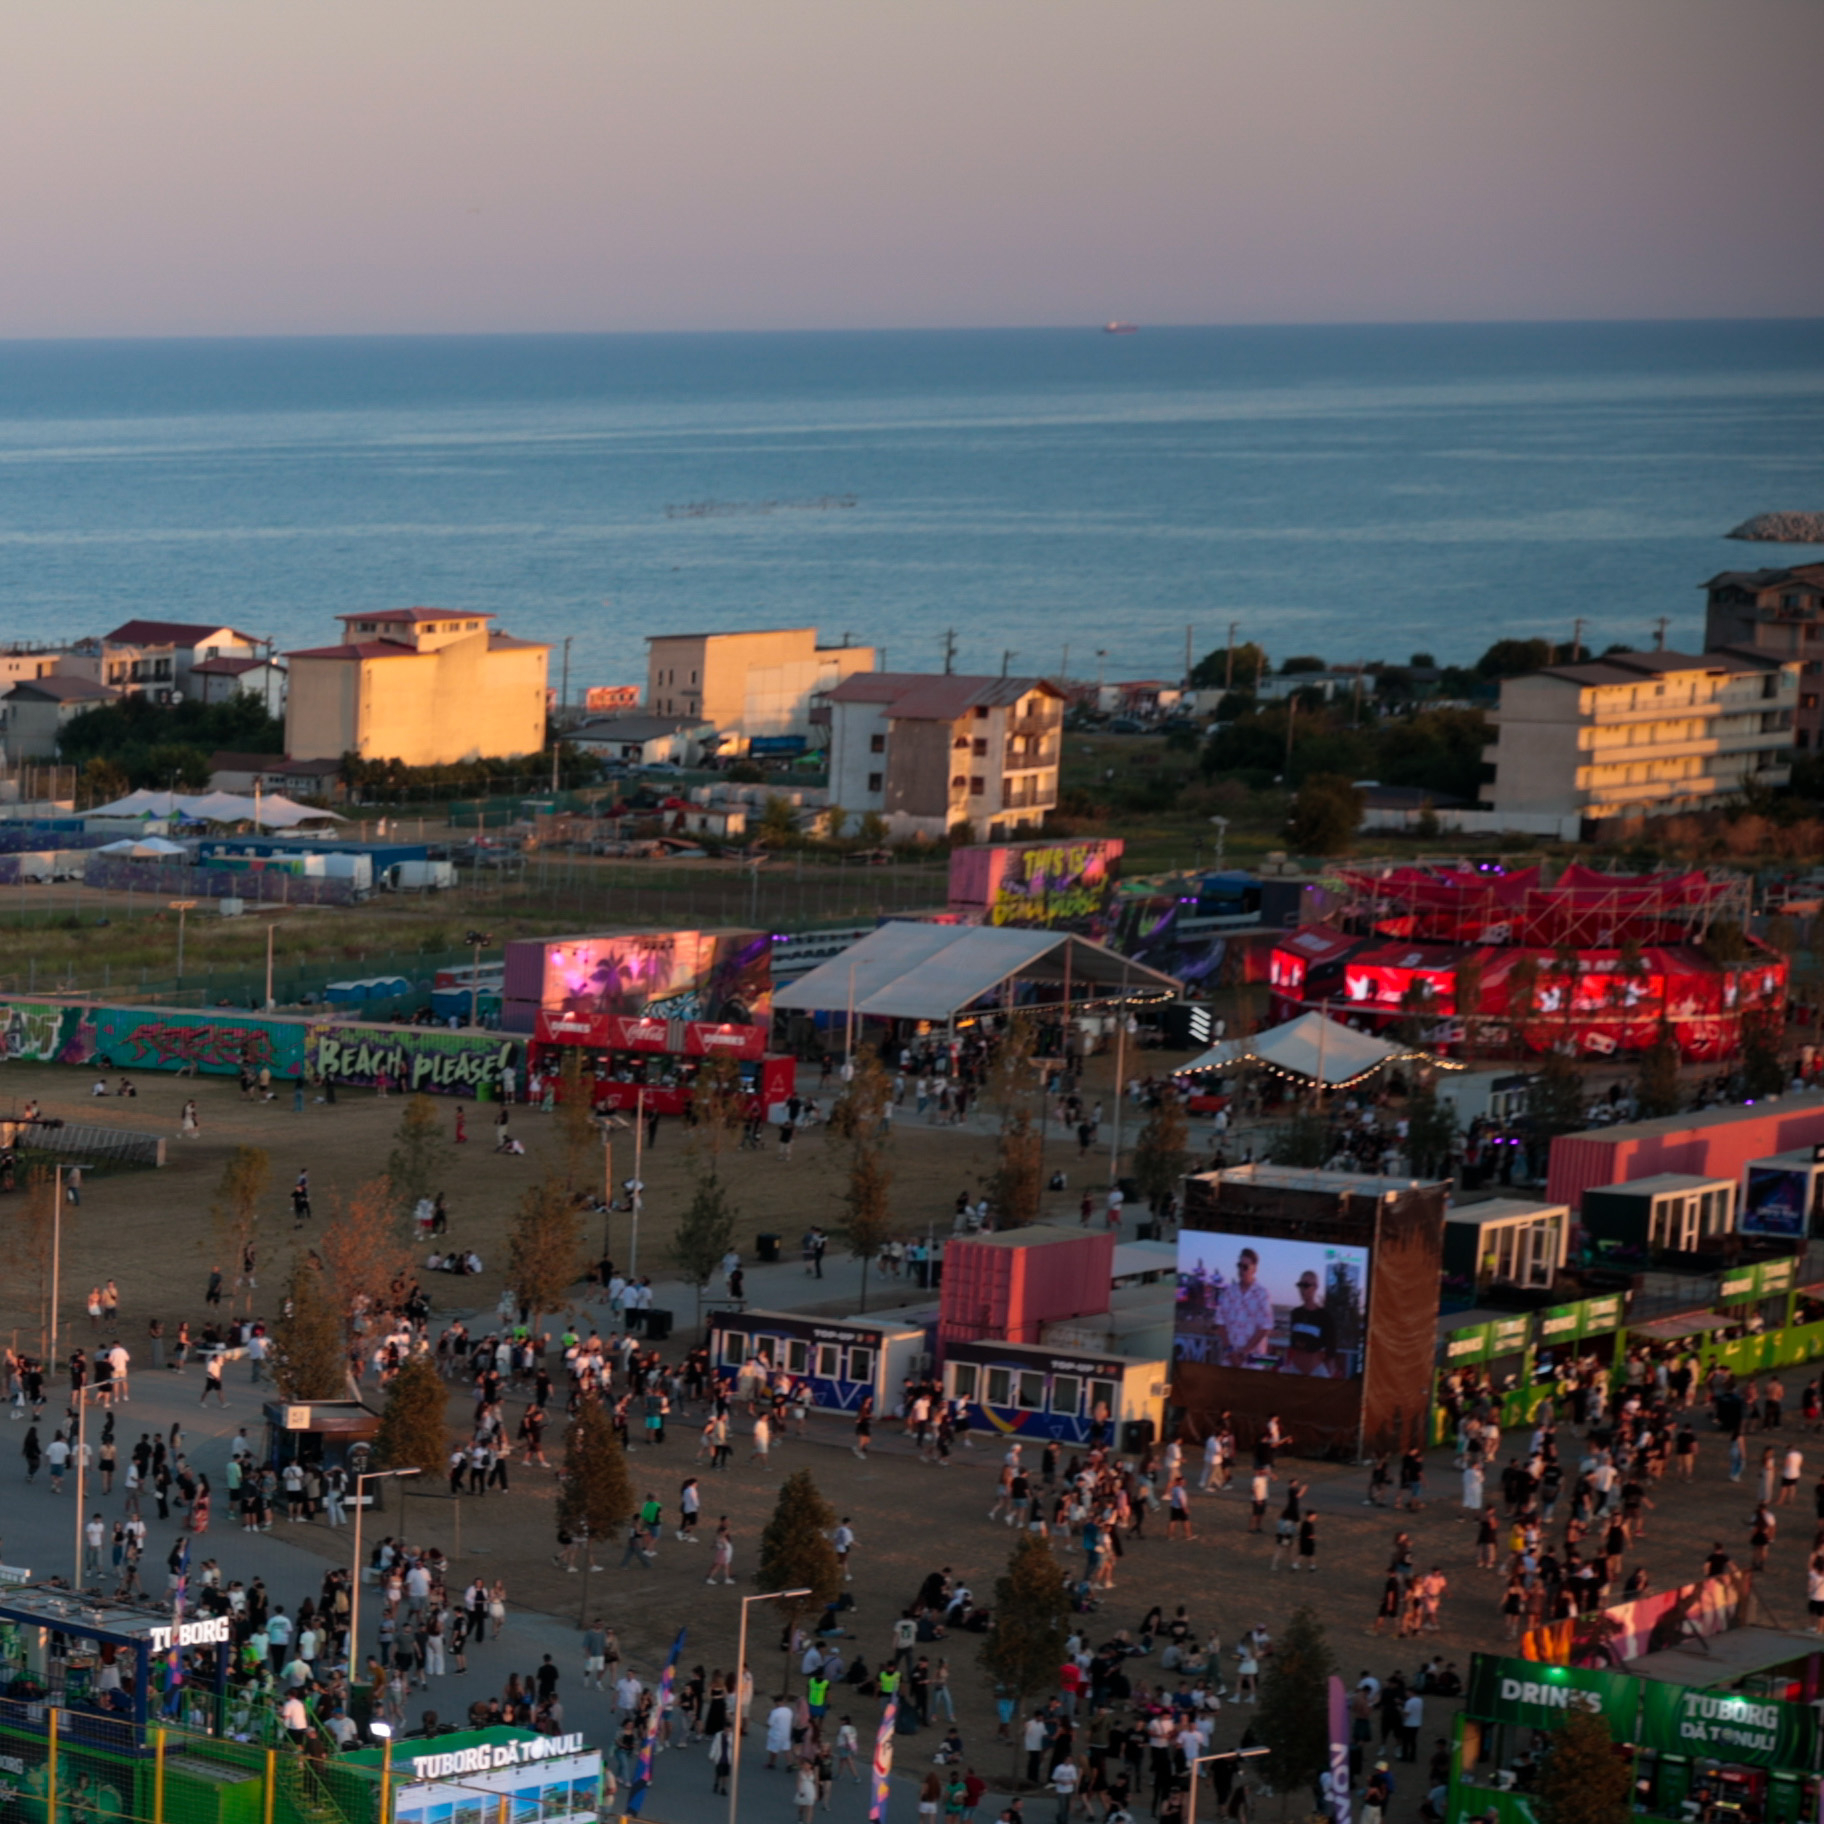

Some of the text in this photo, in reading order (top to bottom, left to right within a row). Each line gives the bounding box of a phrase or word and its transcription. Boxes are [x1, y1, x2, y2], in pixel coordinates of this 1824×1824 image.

[317, 1036, 403, 1077] BEACH
[412, 1042, 512, 1090] PLEASE!
[813, 1328, 855, 1341] TOP-UP
[1050, 1359, 1096, 1373] TOP-UP
[149, 1615, 230, 1653] TUBORG
[1680, 1719, 1708, 1741] DĂ
[1683, 1693, 1780, 1731] TUBORG
[413, 1744, 492, 1781] TUBORG
[494, 1739, 519, 1768] DĂ
